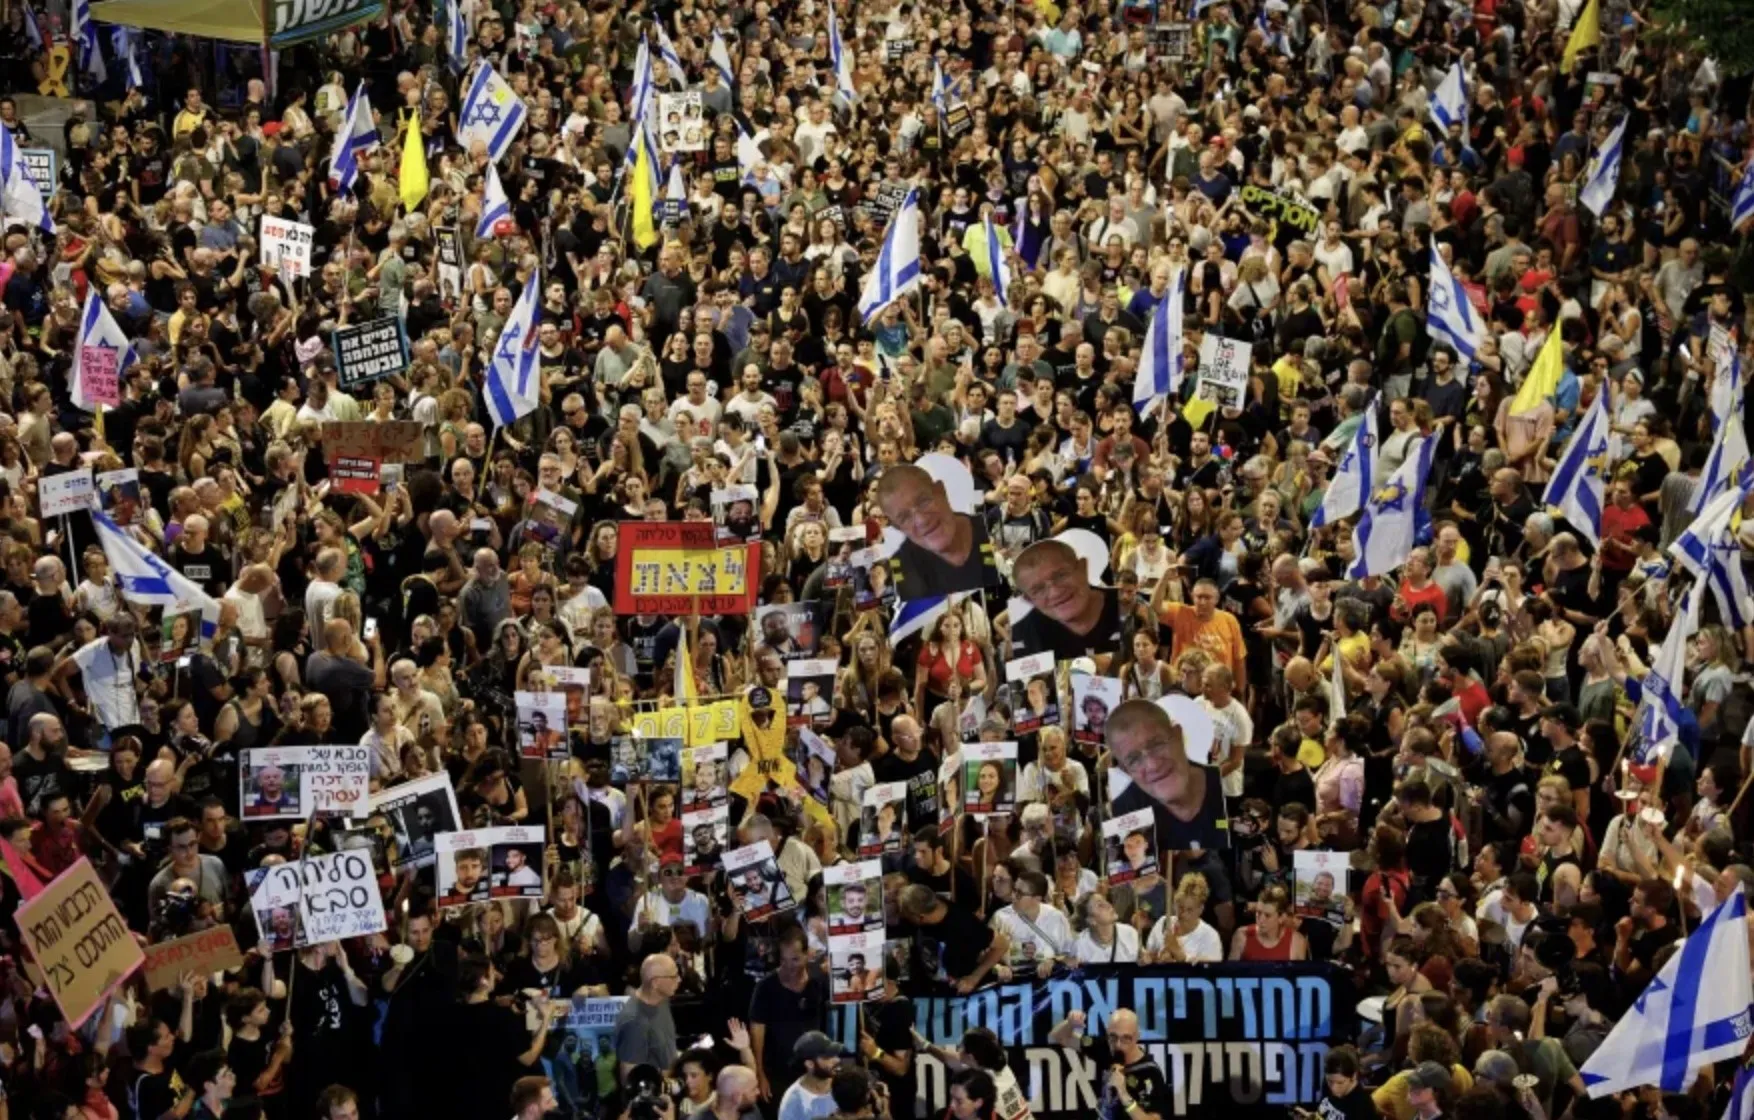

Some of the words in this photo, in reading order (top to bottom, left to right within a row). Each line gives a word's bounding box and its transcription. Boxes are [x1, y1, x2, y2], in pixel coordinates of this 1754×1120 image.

[341, 336, 359, 351] את
[361, 325, 397, 346] לסיים
[342, 339, 398, 364] המלחמה
[343, 352, 403, 380] עכשיו!
[634, 551, 742, 593] לצאת
[306, 747, 331, 760] שלי
[334, 747, 367, 761] סבא
[275, 853, 367, 890] סליחה
[304, 886, 369, 917] סבא
[1047, 978, 1119, 1038] את
[1133, 977, 1332, 1040] מחזירים
[1025, 1047, 1098, 1113] את
